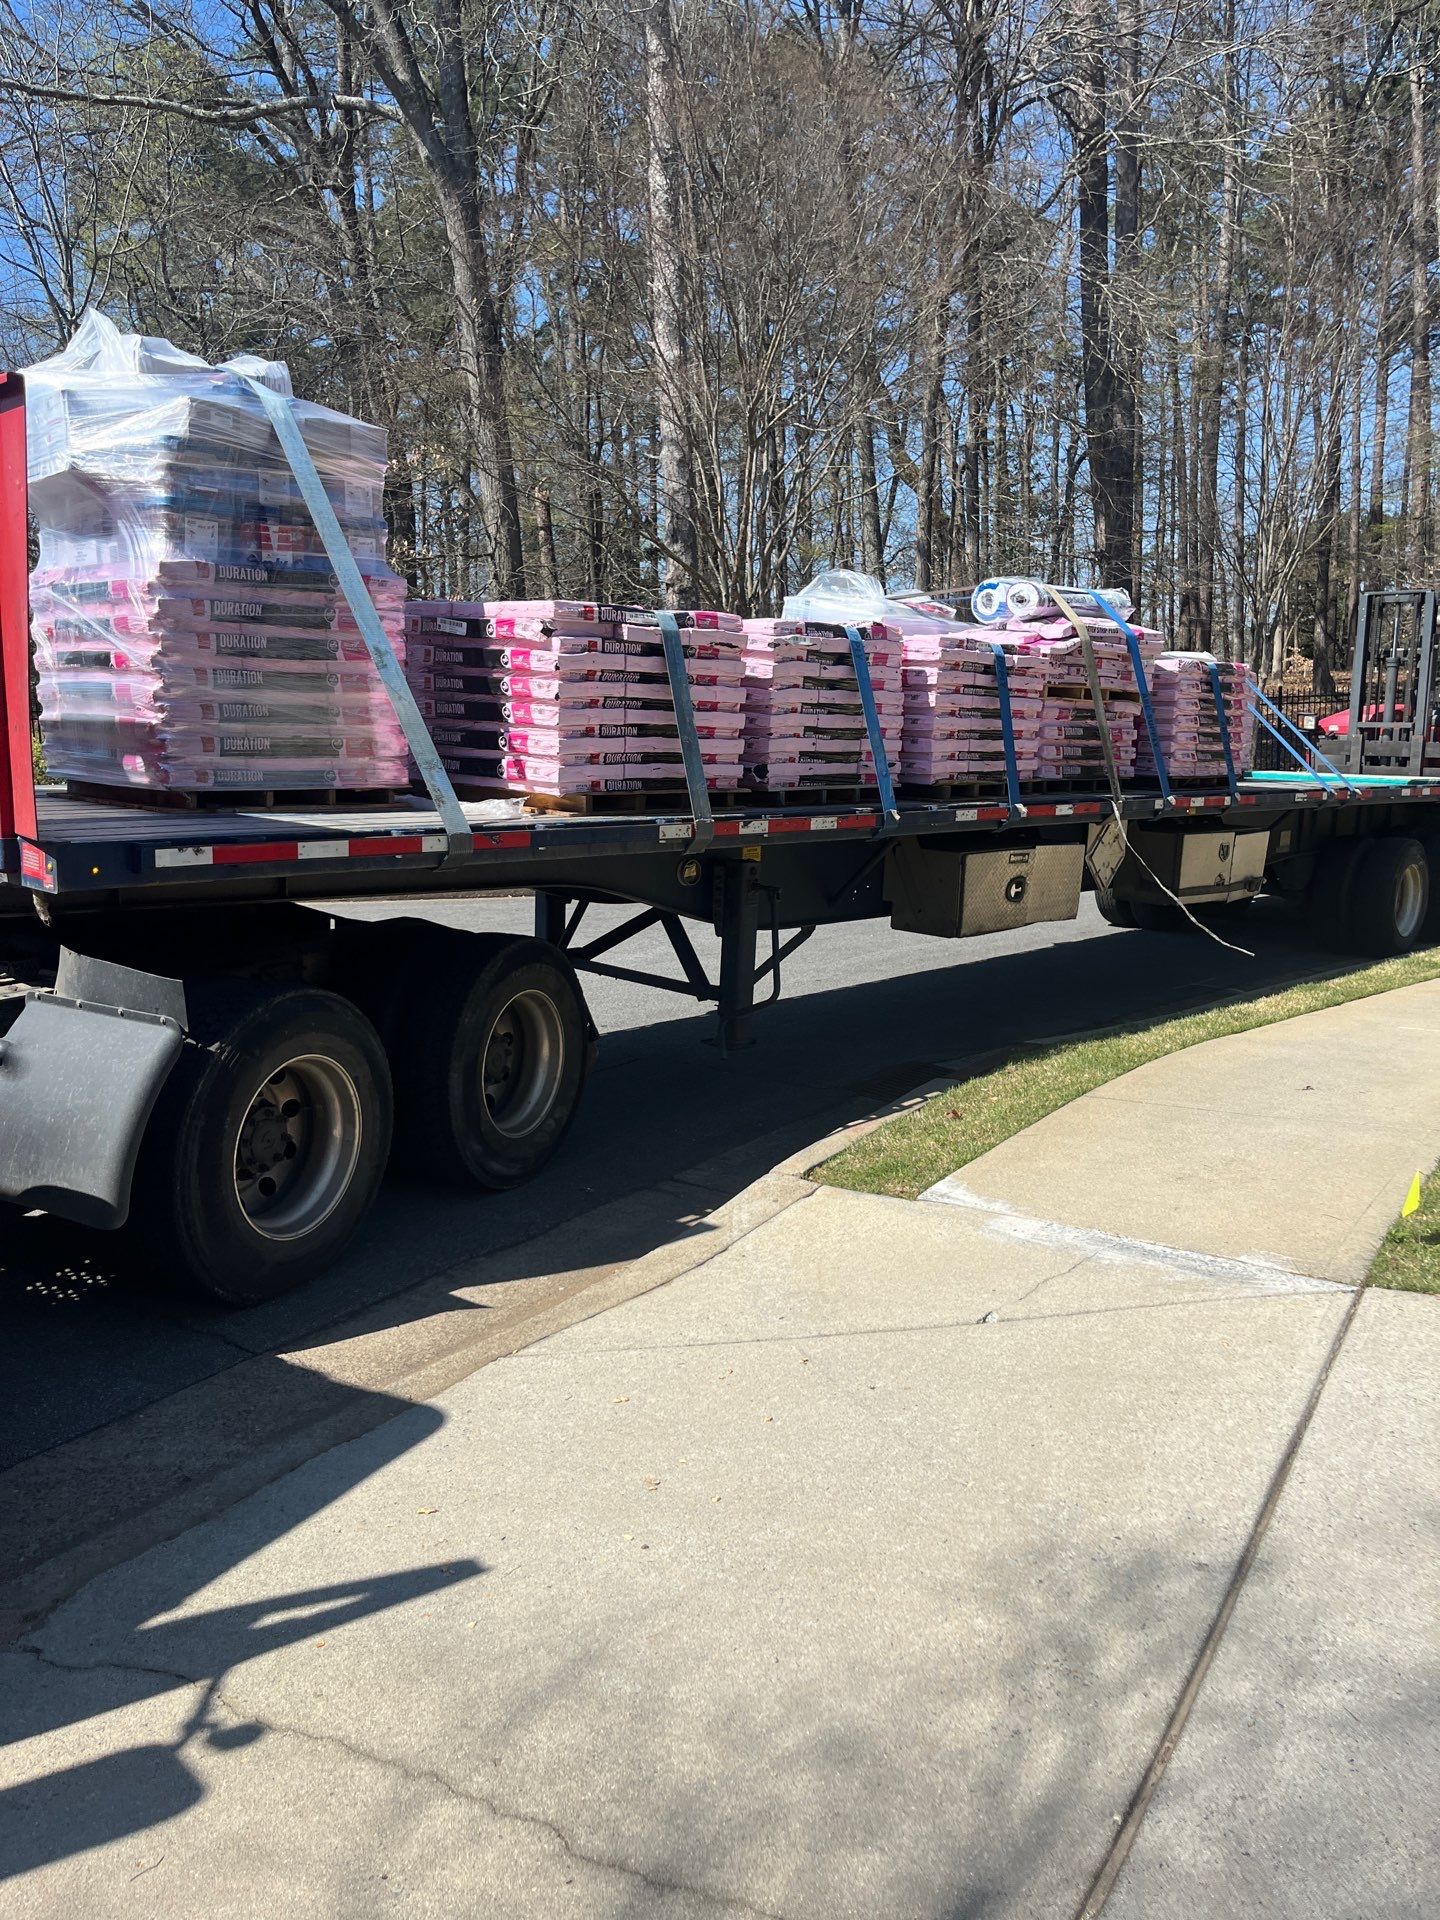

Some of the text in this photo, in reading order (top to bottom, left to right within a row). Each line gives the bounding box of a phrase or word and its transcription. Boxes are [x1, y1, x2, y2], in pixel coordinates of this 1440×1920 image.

[219, 566, 268, 581] DURATION
[214, 601, 263, 615] DURATION
[600, 608, 627, 622] DURAT
[219, 633, 267, 649] DURATION
[604, 641, 642, 654] DURATION
[435, 651, 464, 663] DURATION
[216, 670, 264, 685] DURATION
[435, 677, 464, 689] DURATION
[601, 672, 641, 682] DURATION
[222, 703, 269, 717] DURATION
[436, 703, 465, 715] DURATION
[604, 699, 643, 709] DURATION
[601, 726, 638, 736] DURATION
[223, 737, 271, 751] DURATION
[605, 753, 643, 763] DURATION
[216, 770, 264, 782] DURATION
[606, 780, 642, 791] DURATION
